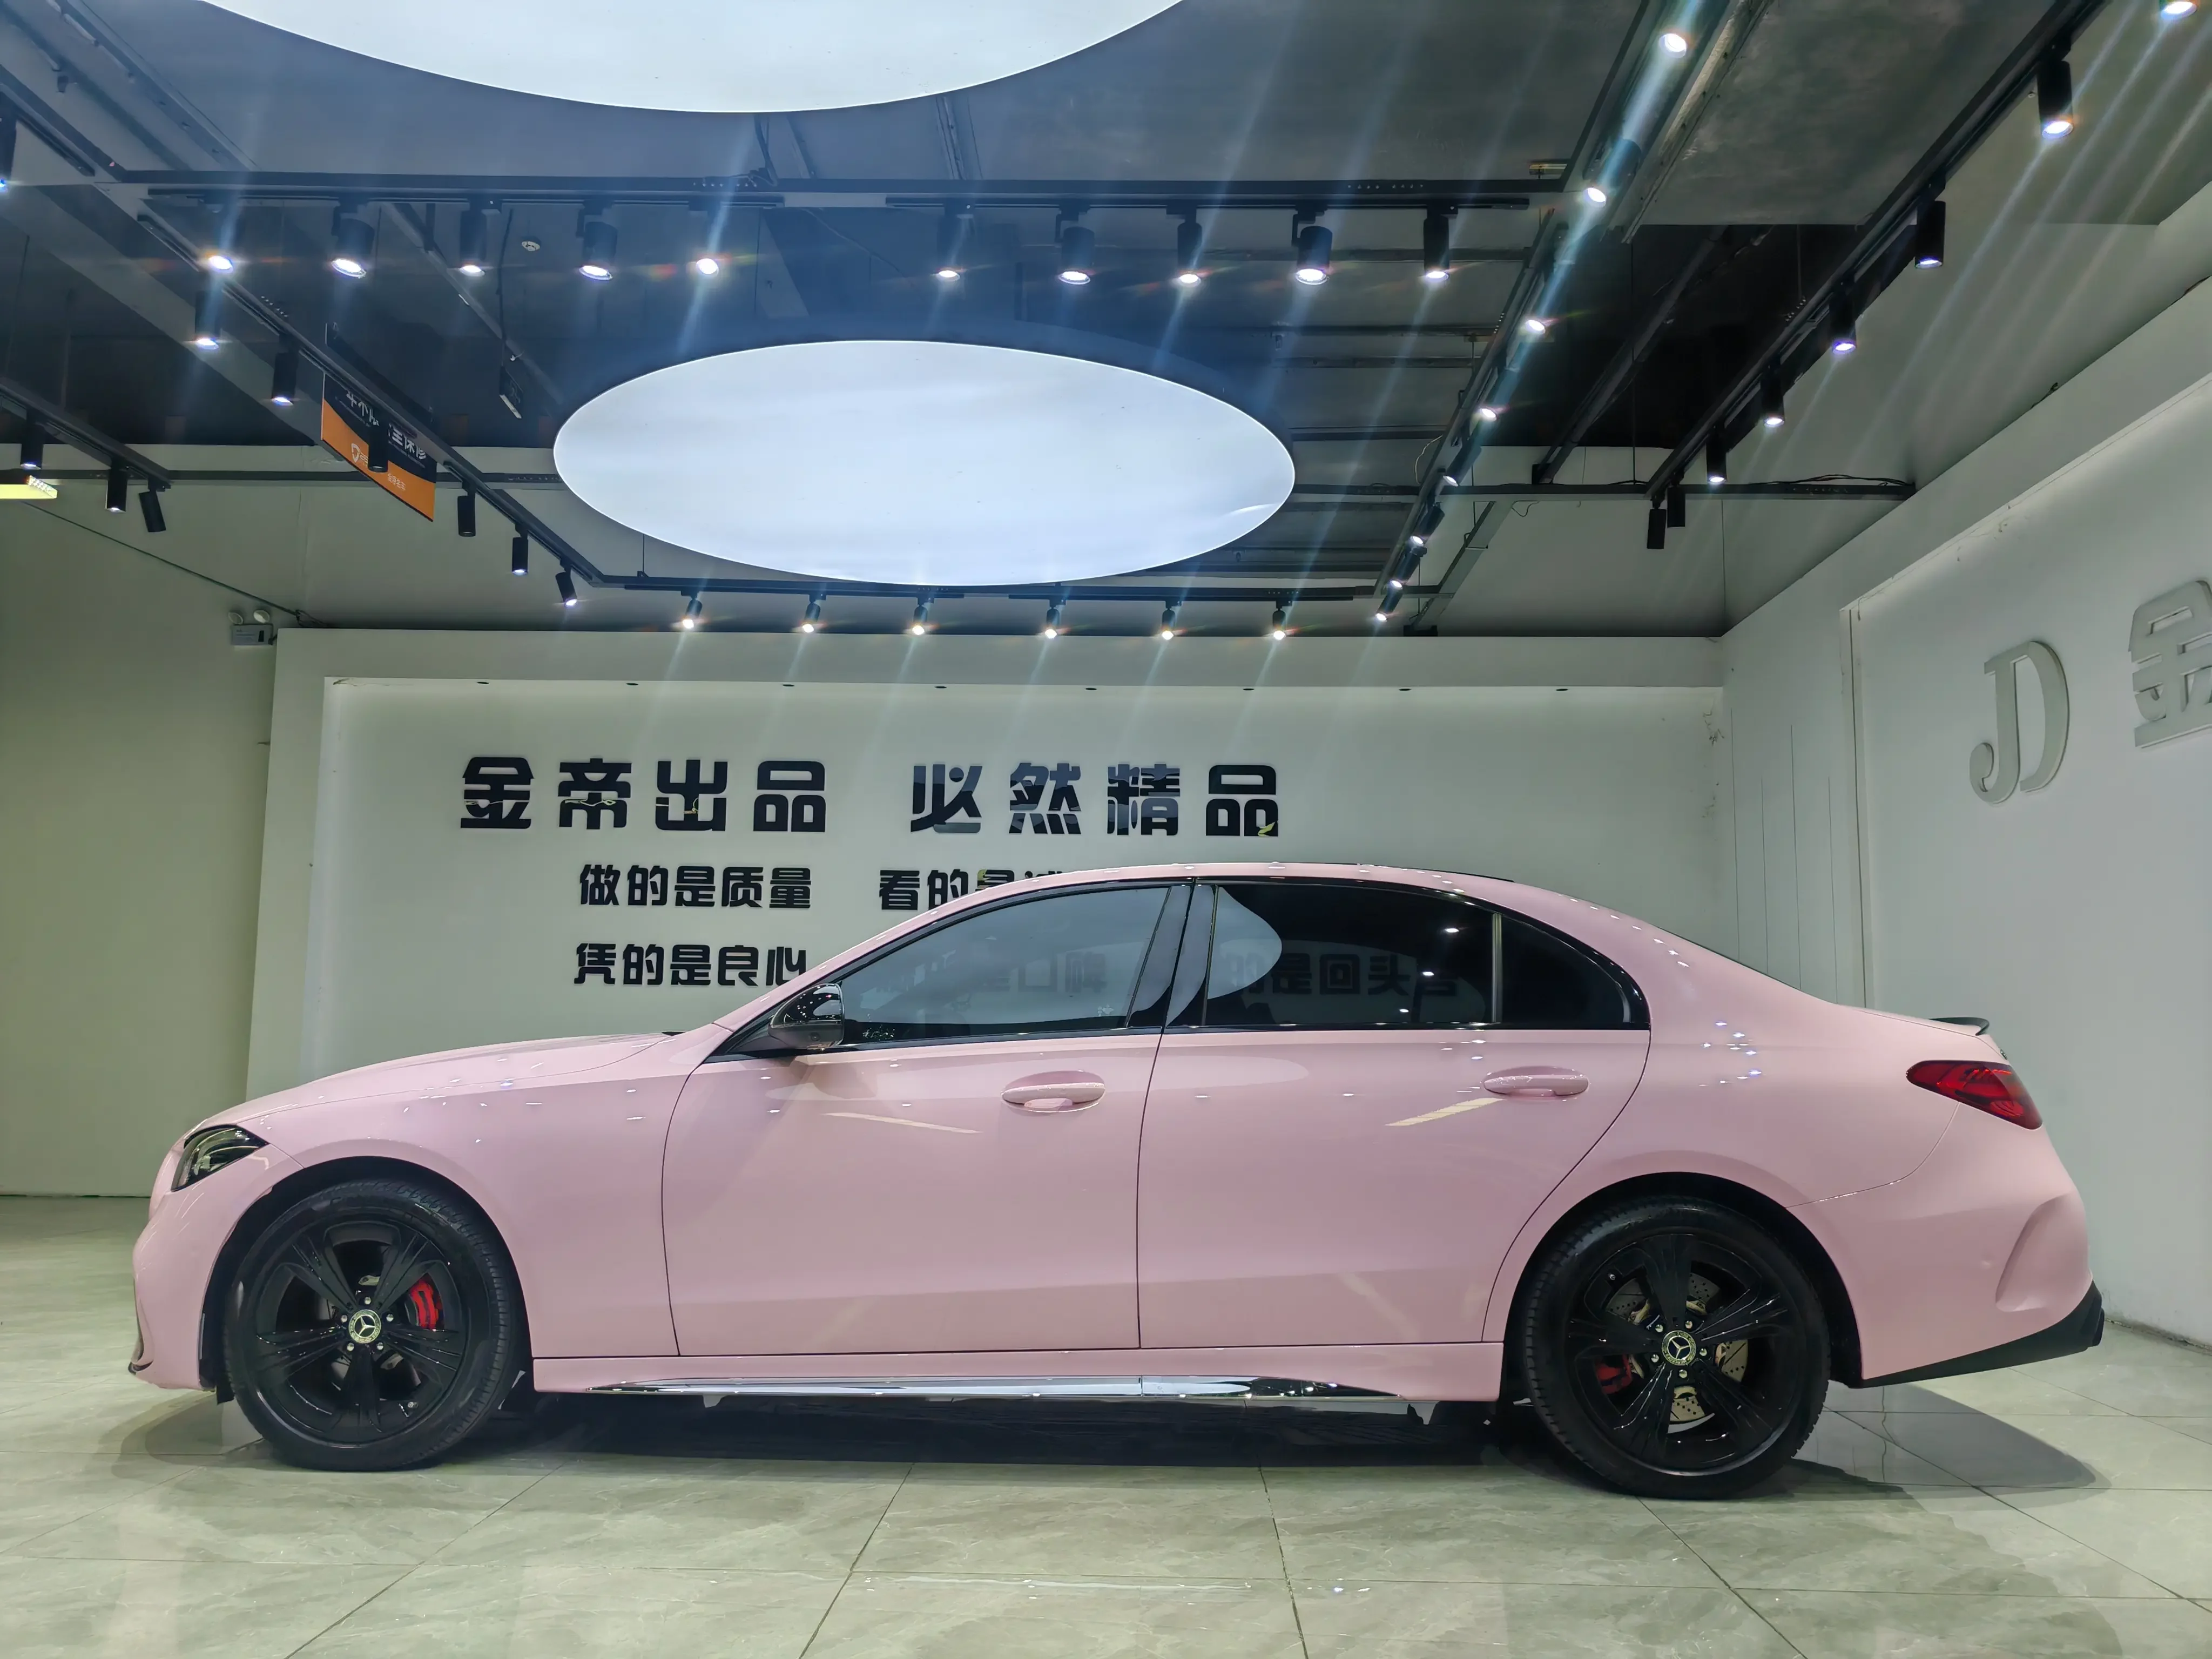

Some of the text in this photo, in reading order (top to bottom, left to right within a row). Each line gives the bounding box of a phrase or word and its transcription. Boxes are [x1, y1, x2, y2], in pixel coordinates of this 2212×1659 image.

[461, 757, 1279, 837] 金帝出品 必然精品
[579, 864, 812, 909] 做的是质量
[574, 943, 806, 986] 凭的是良心
